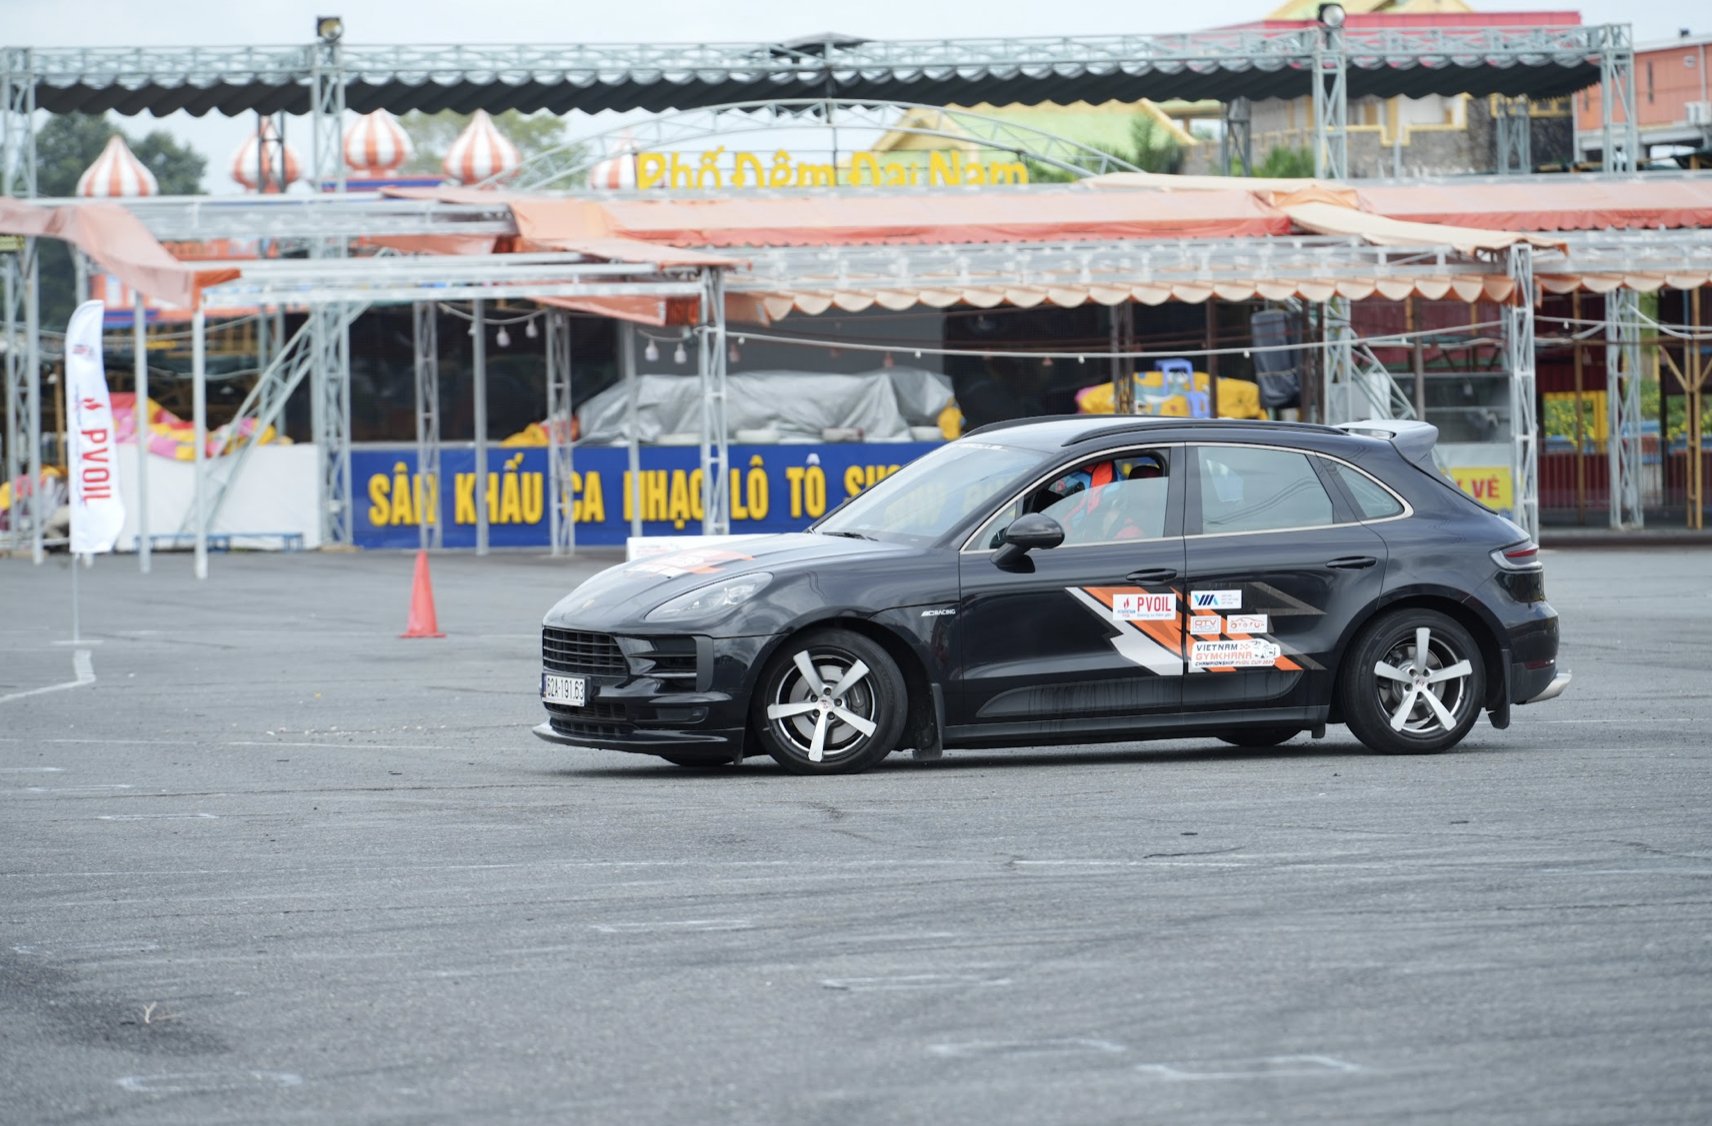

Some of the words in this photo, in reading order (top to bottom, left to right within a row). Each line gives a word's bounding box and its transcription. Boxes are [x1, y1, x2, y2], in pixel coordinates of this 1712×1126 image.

[929, 149, 1030, 187] Nam
[80, 428, 112, 507] PVOIL
[368, 461, 438, 526] SÂN
[454, 452, 544, 525] KHẤU
[730, 454, 769, 521] LÔ
[785, 452, 827, 519] TÔ
[1137, 596, 1172, 612] PVOIL
[1196, 643, 1238, 652] VIETNAM
